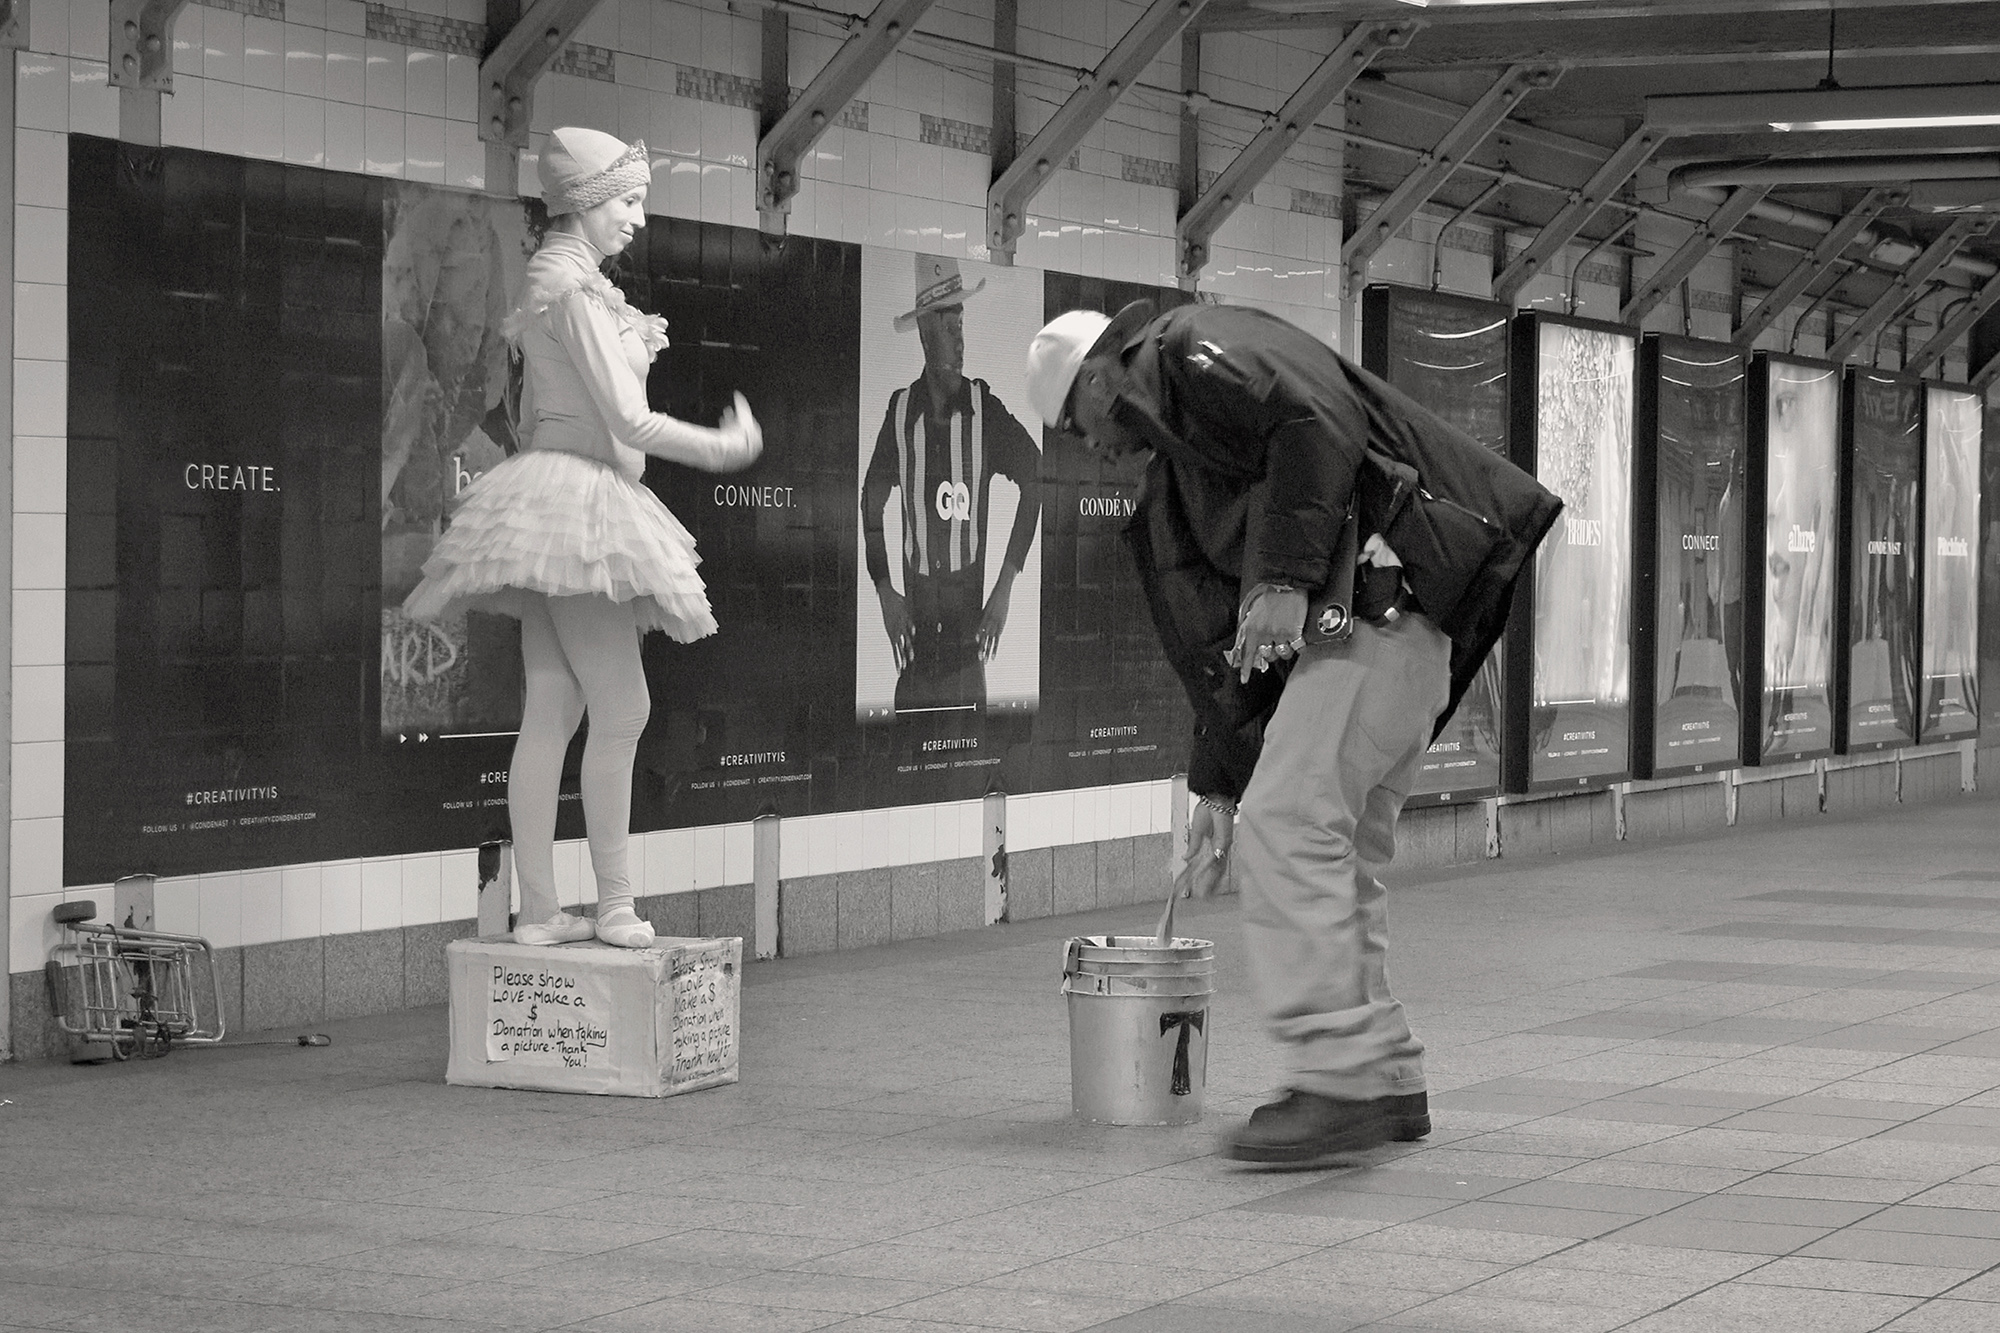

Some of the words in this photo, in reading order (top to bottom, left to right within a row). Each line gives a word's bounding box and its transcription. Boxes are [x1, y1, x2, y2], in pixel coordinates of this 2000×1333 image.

[185, 463, 281, 492] CREATE.
[714, 484, 798, 509] CONNECT.
[935, 480, 970, 521] GQ
[1080, 491, 1121, 517] CONDÉ
[1567, 518, 1601, 547] BRIDES
[1788, 524, 1816, 553] allure
[1090, 725, 1138, 738] #CREATIVITYIS
[922, 738, 979, 752] #CREATIVITYIS
[720, 751, 787, 766] #CREATIVITYIS
[186, 786, 279, 805] #CREATIVITYIS
[143, 825, 168, 834] FOLLOW
[169, 824, 178, 832] US
[493, 965, 534, 986] Please
[538, 968, 575, 989] show
[493, 989, 525, 1003] LOVE
[533, 990, 570, 1006] Make
[573, 996, 586, 1007] a
[527, 1003, 538, 1022] $
[493, 1018, 543, 1037] Donation
[547, 1019, 574, 1040] when
[575, 1021, 608, 1048] taking
[501, 1042, 510, 1052] a
[556, 1040, 587, 1054] Thank
